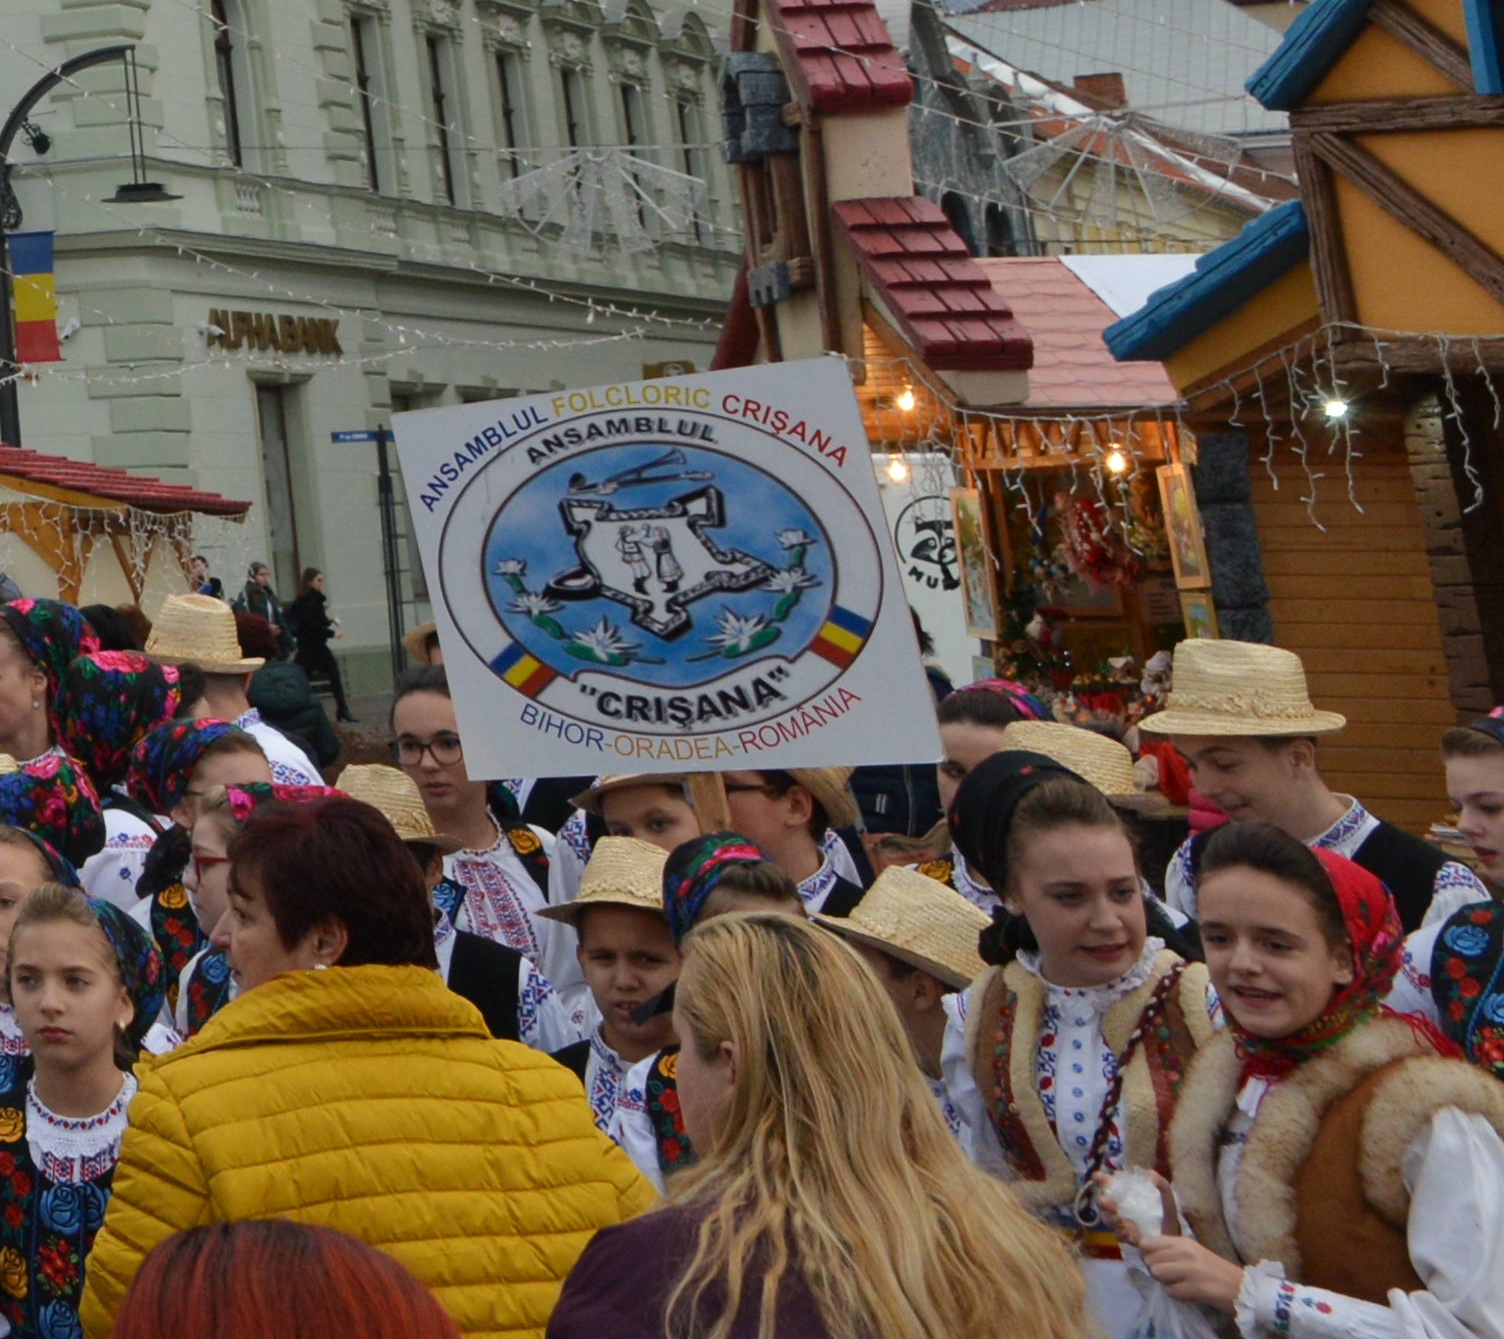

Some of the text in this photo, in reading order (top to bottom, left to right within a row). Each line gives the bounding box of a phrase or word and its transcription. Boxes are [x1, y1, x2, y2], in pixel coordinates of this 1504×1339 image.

[419, 405, 549, 513] ANSAMBLUL
[550, 384, 711, 418] FOLCLORIC
[525, 416, 718, 465] ANSAMBLUL
